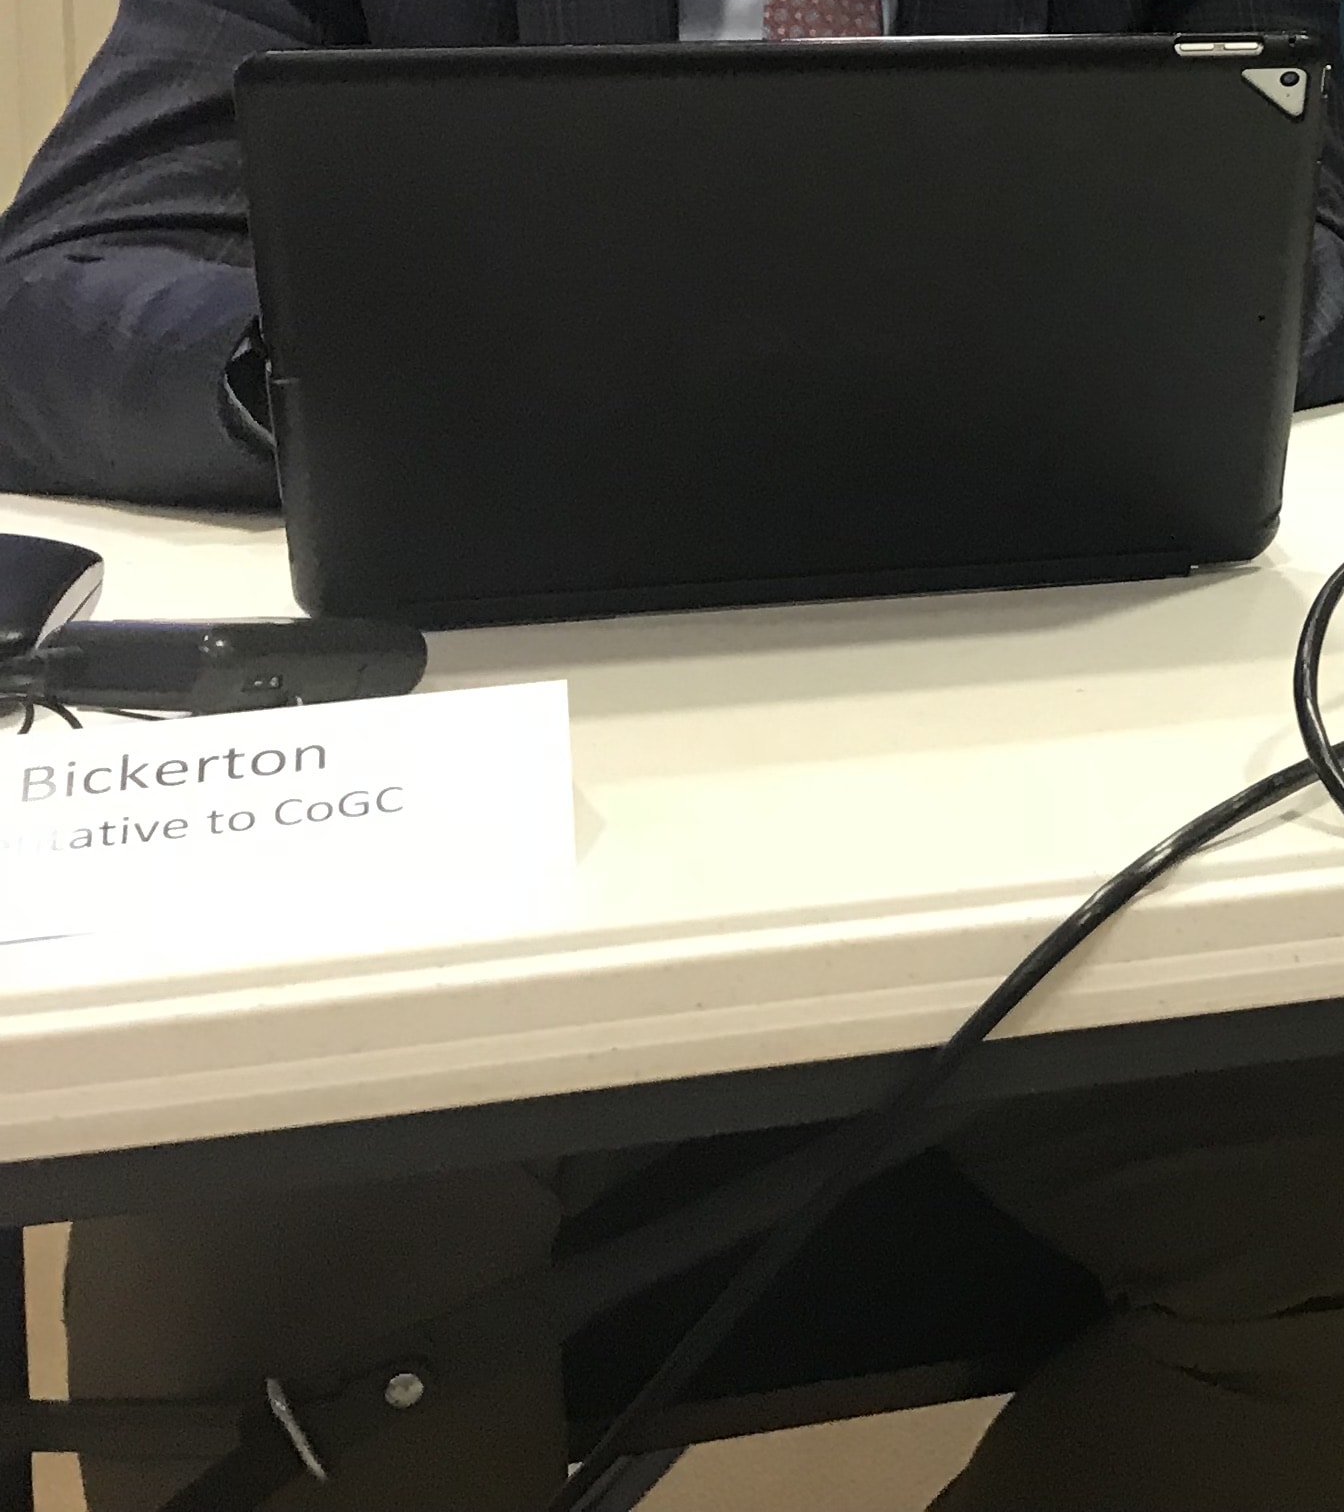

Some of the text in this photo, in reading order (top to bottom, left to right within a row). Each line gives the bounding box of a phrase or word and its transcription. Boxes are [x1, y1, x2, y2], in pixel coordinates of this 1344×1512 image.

[21, 743, 327, 803] Bickerton
[206, 809, 257, 835] to
[274, 786, 405, 826] CoGC
